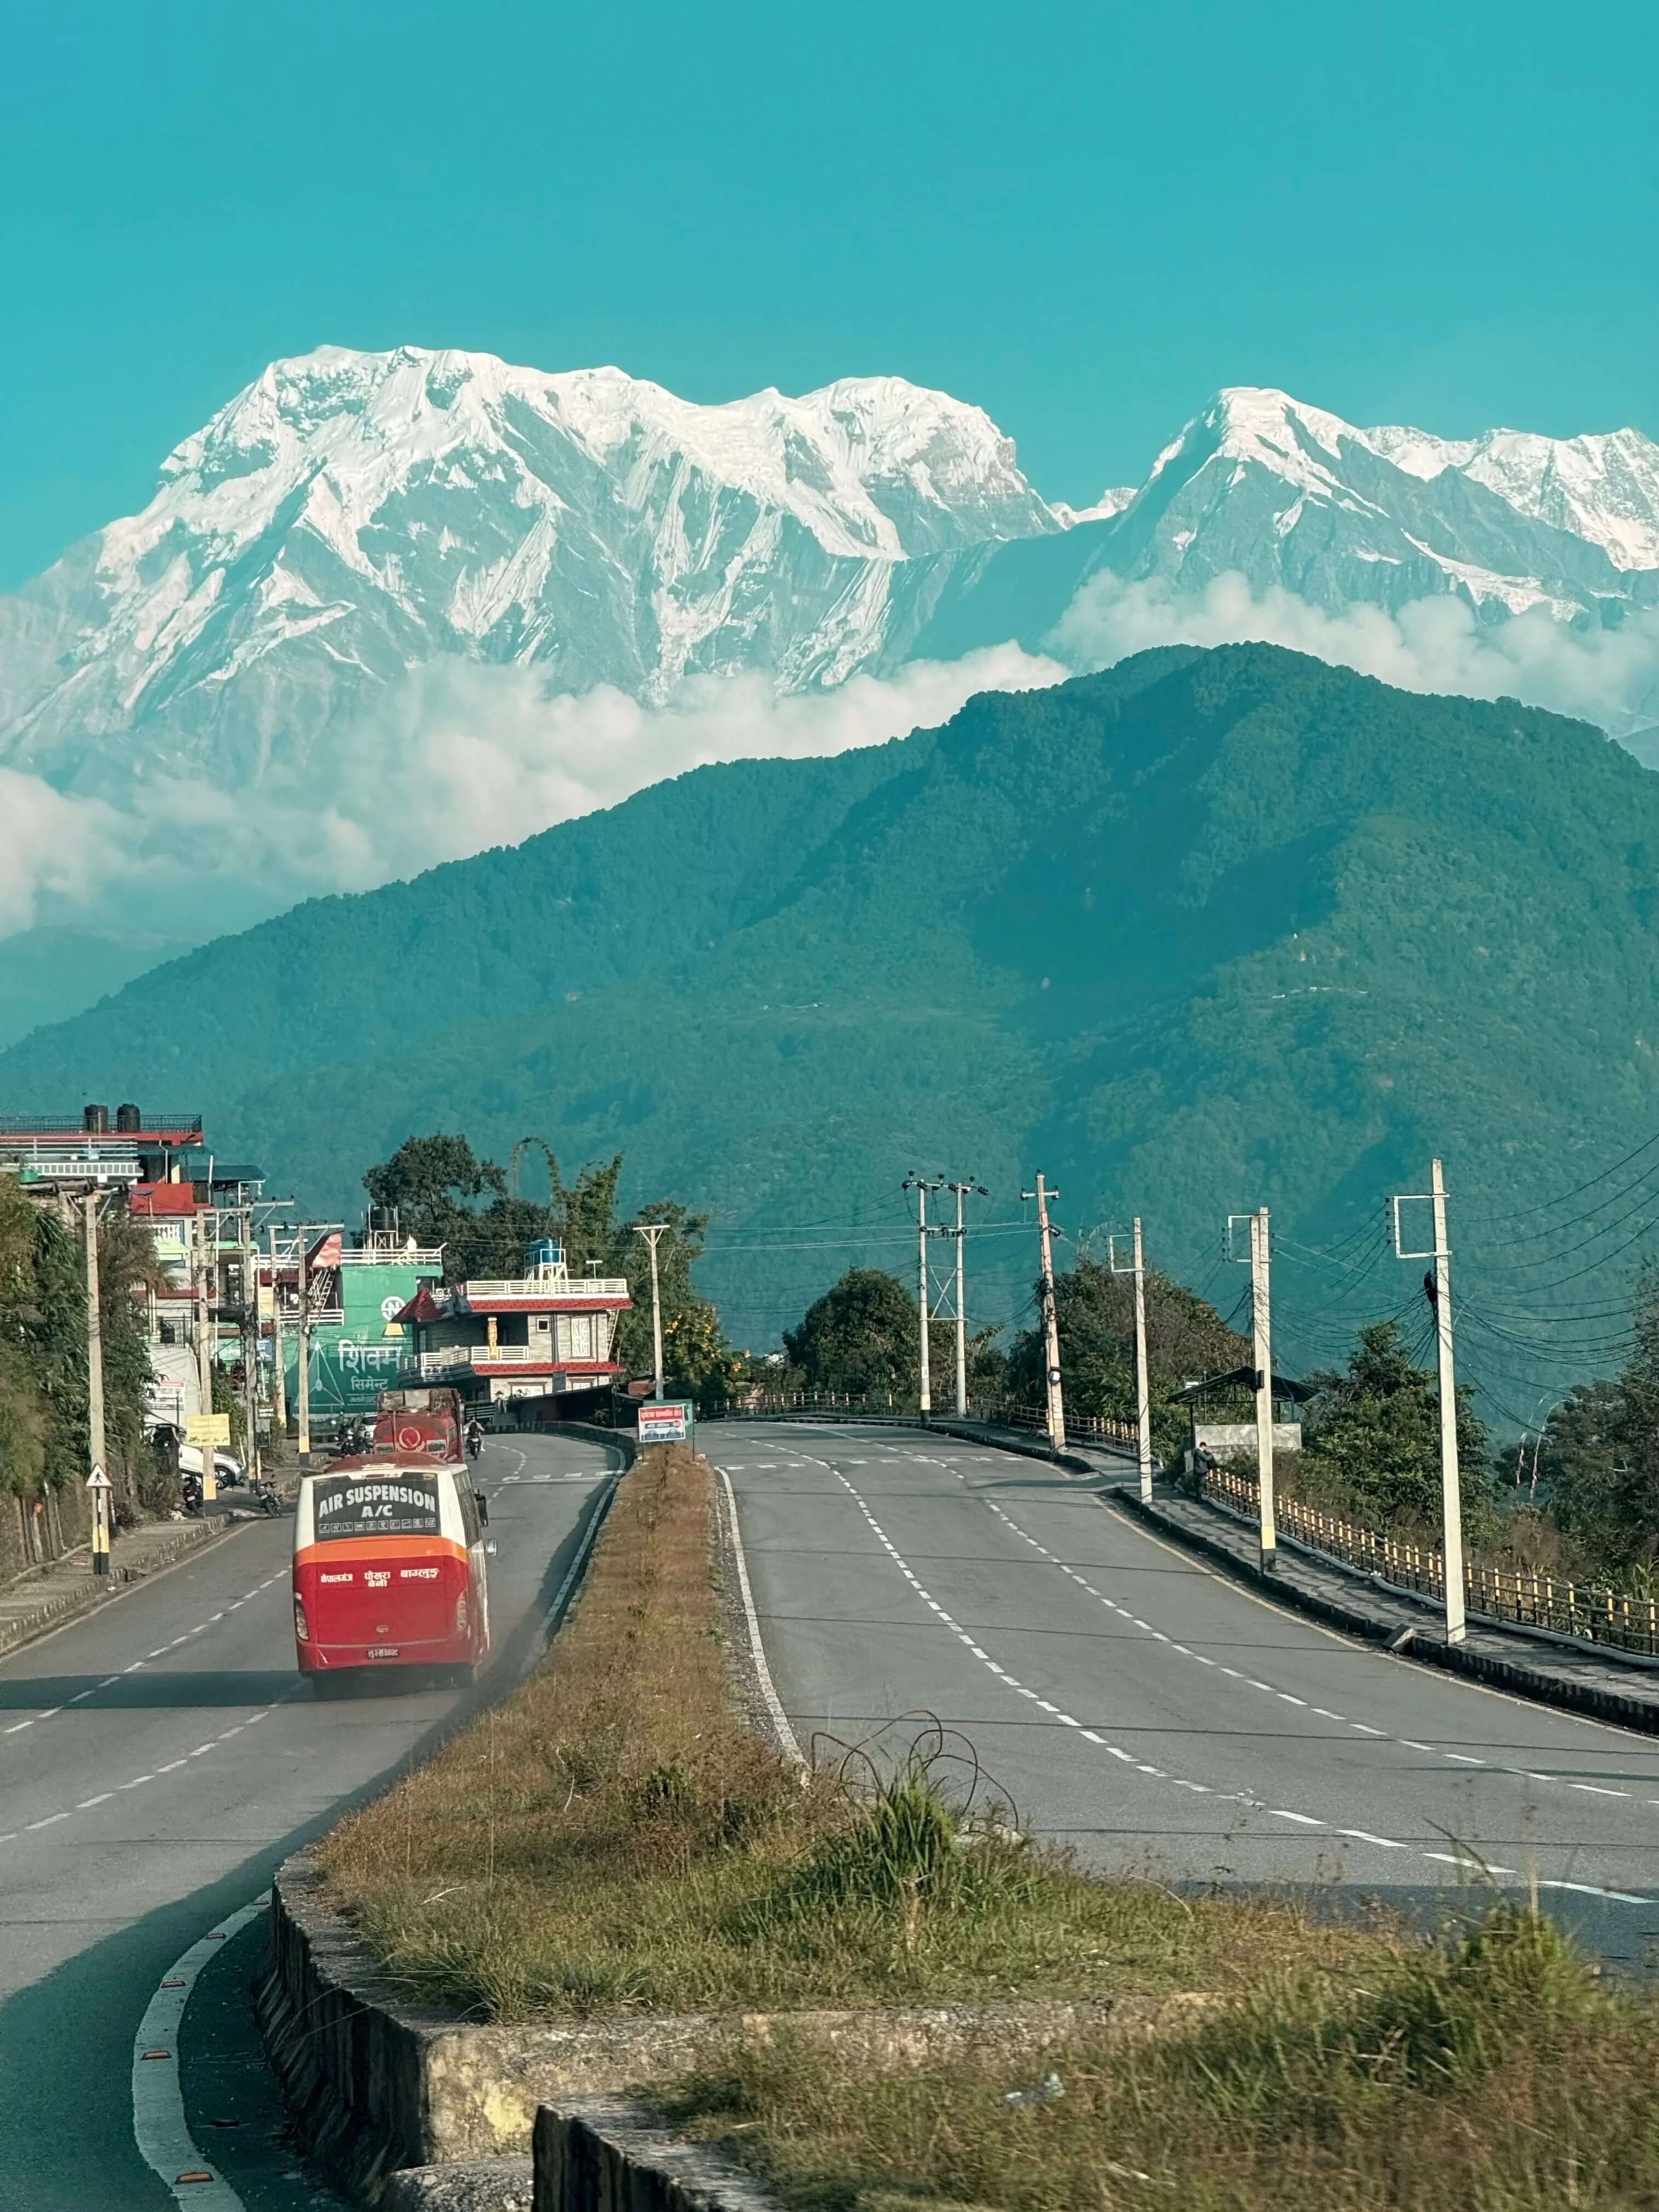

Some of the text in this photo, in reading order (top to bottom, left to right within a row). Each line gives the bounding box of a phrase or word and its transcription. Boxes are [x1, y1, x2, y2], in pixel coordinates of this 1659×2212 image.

[351, 1375, 390, 1391] सिमेन्ट
[319, 1485, 436, 1519] AIR SUSPENSION
[361, 1504, 393, 1518] A/C
[364, 1570, 391, 1581] पोखरा
